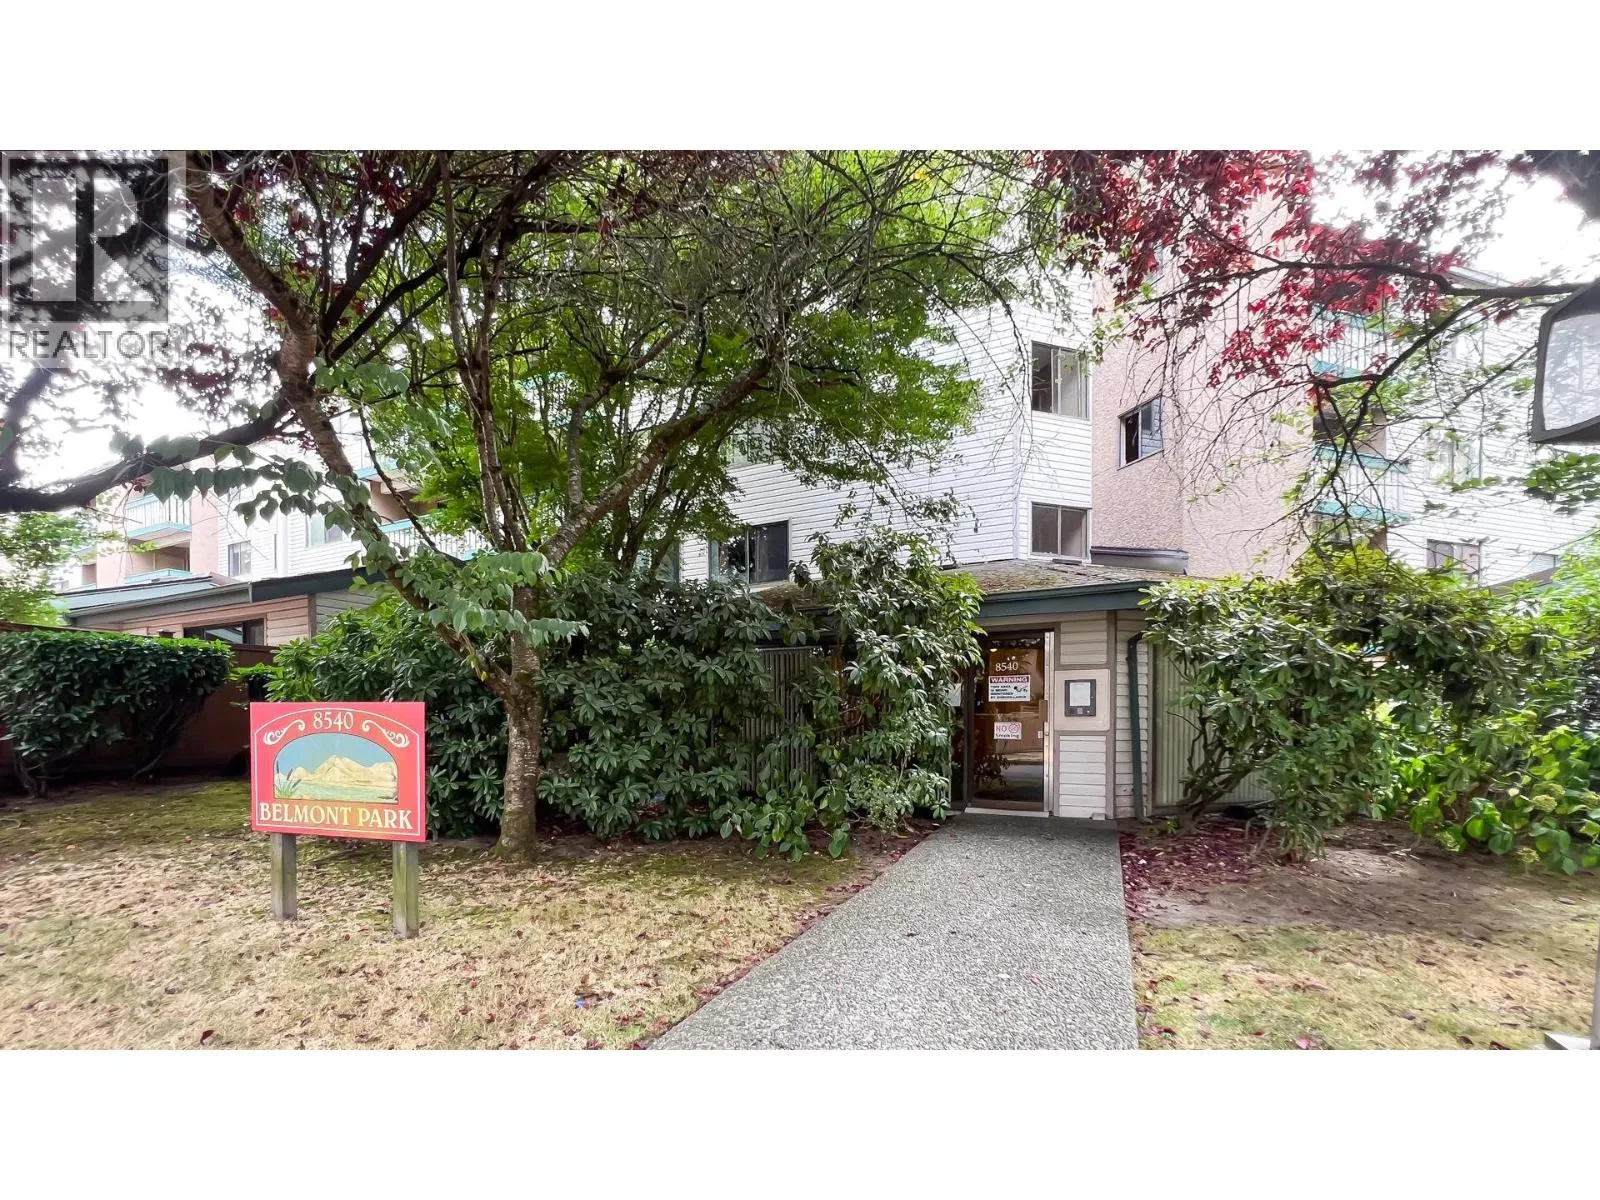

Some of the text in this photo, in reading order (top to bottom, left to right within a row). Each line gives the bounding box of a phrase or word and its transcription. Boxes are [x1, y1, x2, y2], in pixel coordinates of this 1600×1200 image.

[995, 662, 1018, 671] 8540
[313, 711, 354, 731] 8540
[996, 724, 1007, 732] NO
[259, 802, 413, 829] BELMONT PARK
